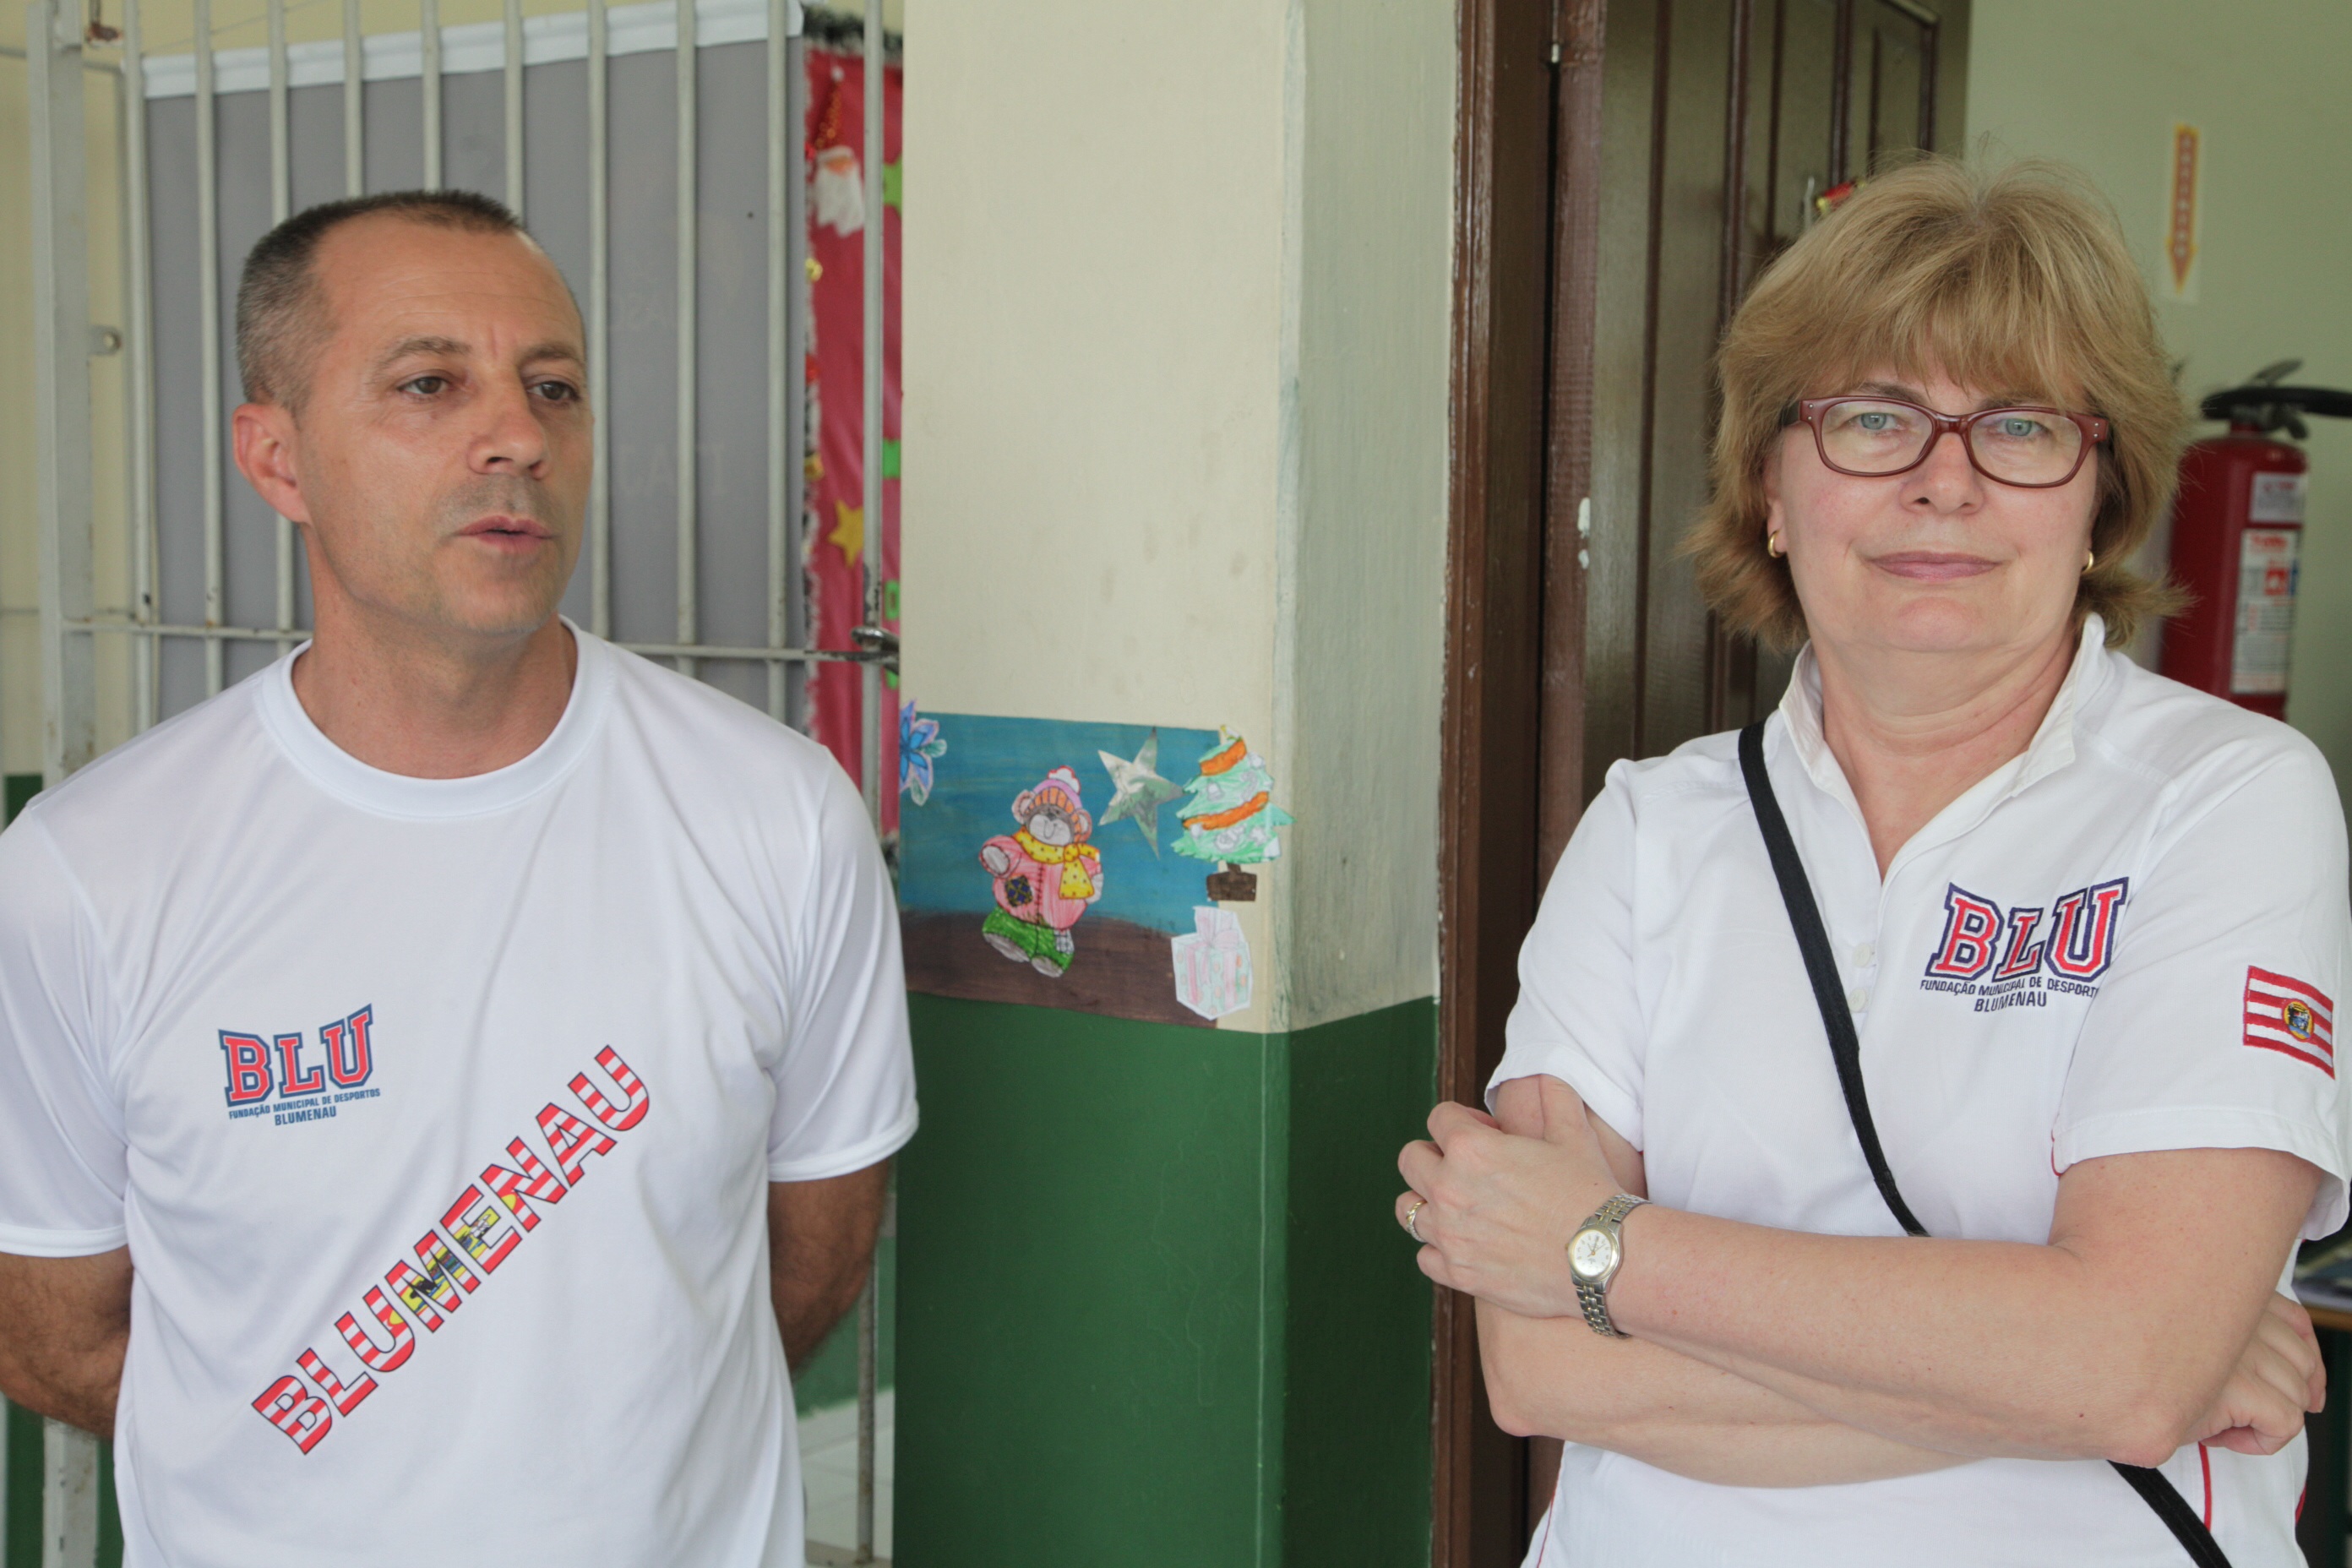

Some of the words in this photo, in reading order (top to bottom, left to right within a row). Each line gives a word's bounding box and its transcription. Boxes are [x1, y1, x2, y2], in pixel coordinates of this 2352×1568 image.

[1925, 876, 2130, 983] BLU
[1919, 979, 1977, 996] FUNDAÇÃO
[1978, 977, 2026, 996] MUNICIPAL
[2029, 976, 2042, 988] DE
[1974, 991, 2047, 1012] BLUMENAU
[217, 1003, 373, 1108] BLU
[228, 1104, 270, 1119] FUNDAÇÃO
[273, 1097, 319, 1113] MUNICIPAL
[322, 1095, 332, 1105] DE
[334, 1087, 381, 1103] DESPORTOS
[274, 1105, 337, 1126] BLUMENAU
[251, 1044, 650, 1455] BLUMENAU
